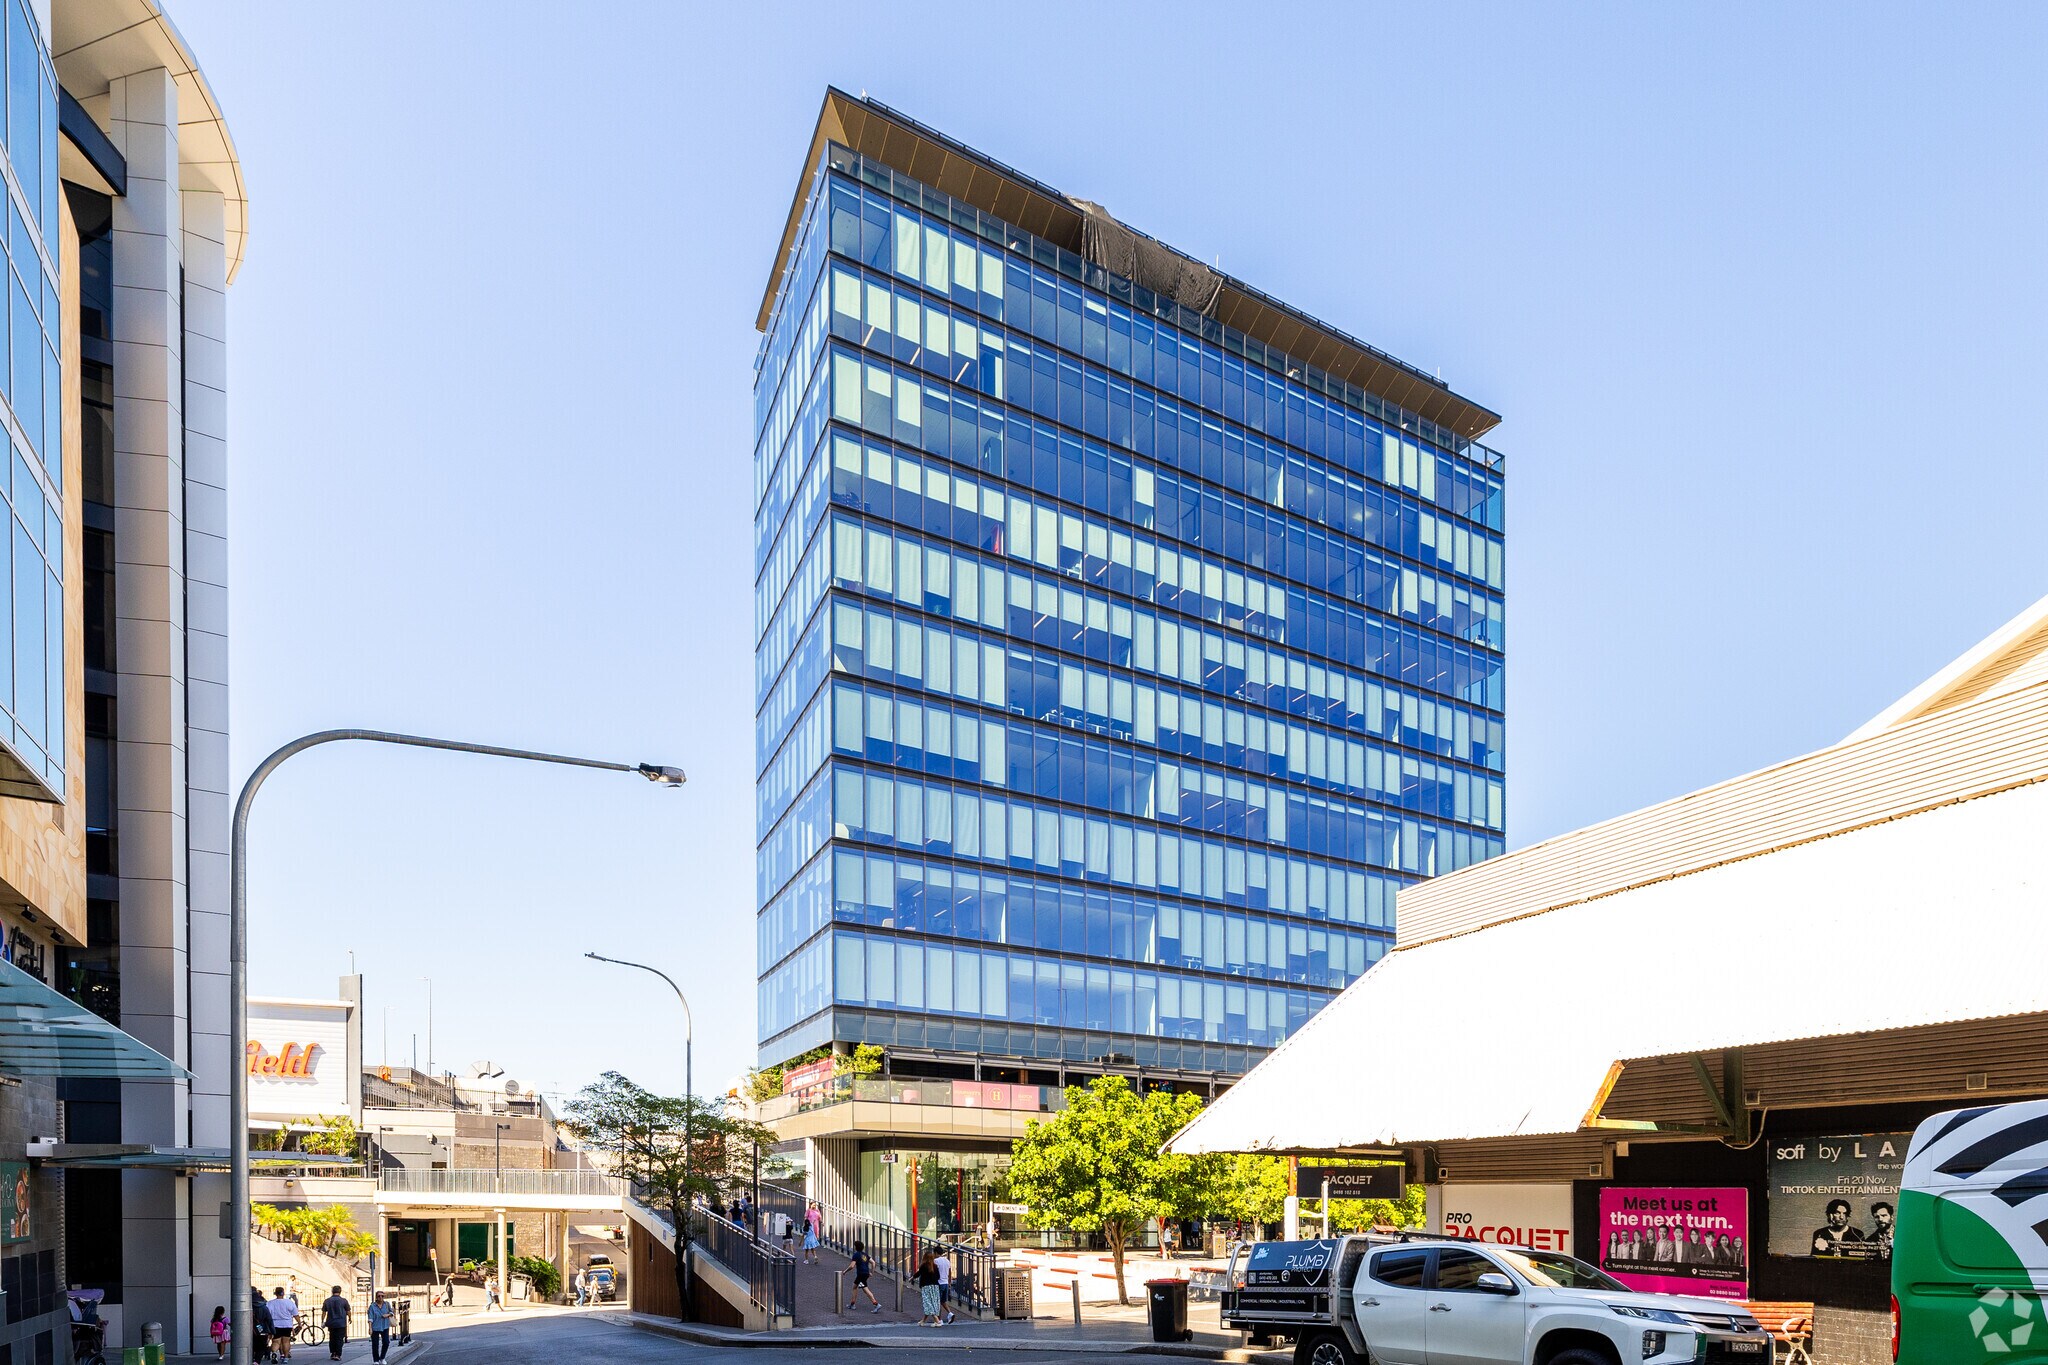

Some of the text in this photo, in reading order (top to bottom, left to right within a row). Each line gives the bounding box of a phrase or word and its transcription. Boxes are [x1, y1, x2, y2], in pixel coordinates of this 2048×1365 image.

[247, 1040, 320, 1078] ield
[1776, 1144, 1806, 1160] soft
[1819, 1143, 1841, 1163] by
[1323, 1175, 1373, 1186] RACQUET
[1837, 1175, 1887, 1184] Fri 20 Nov
[1780, 1185, 1815, 1194] TIKTOK
[1623, 1197, 1718, 1212] Meet us at
[1445, 1212, 1472, 1224] PRO
[1610, 1211, 1733, 1229] the next turn.
[1445, 1224, 1570, 1251] RACQUET
[1285, 1254, 1325, 1267] PLUMB
